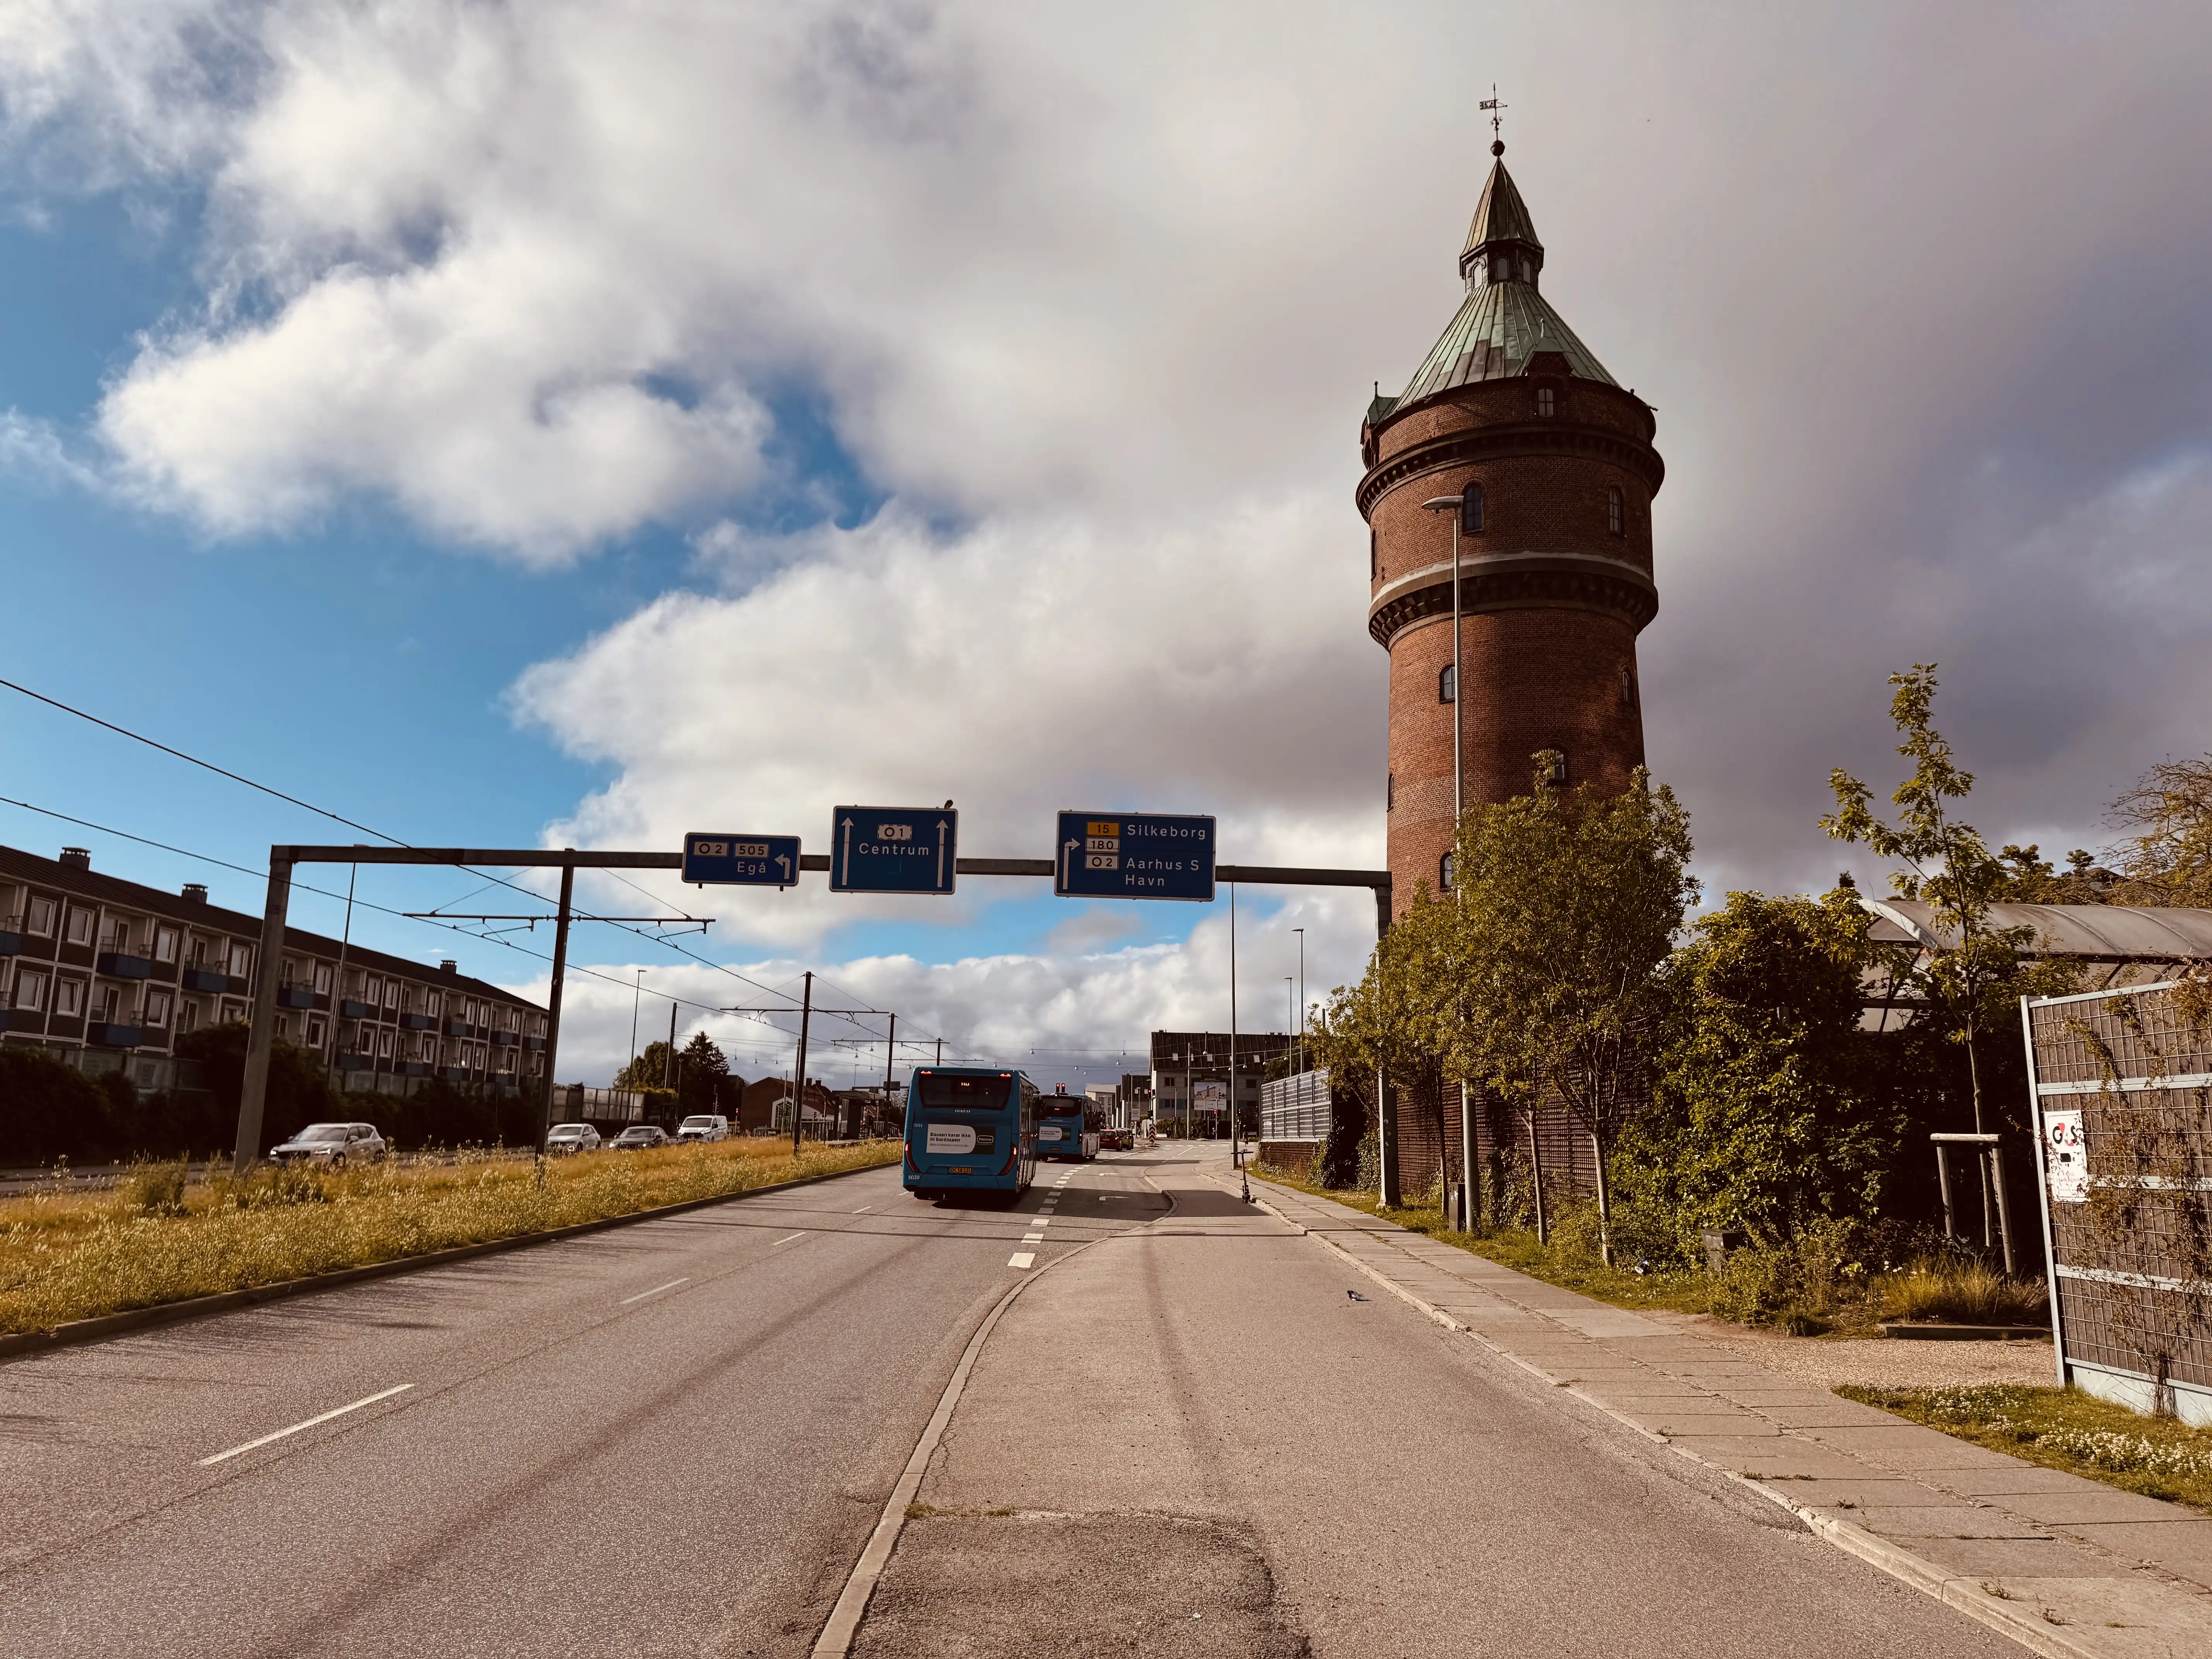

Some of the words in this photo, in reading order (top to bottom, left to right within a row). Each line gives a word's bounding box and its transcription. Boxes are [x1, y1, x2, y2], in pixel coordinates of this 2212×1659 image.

[1097, 824, 1109, 833] 15
[1127, 824, 1206, 840] Silkeborg
[739, 845, 765, 855] 505
[859, 843, 929, 855] Centrum
[1092, 840, 1114, 850] 180
[737, 861, 766, 875] Egå
[1126, 858, 1182, 870] Aarhus
[1190, 860, 1199, 871] S
[1125, 874, 1164, 886] Havn
